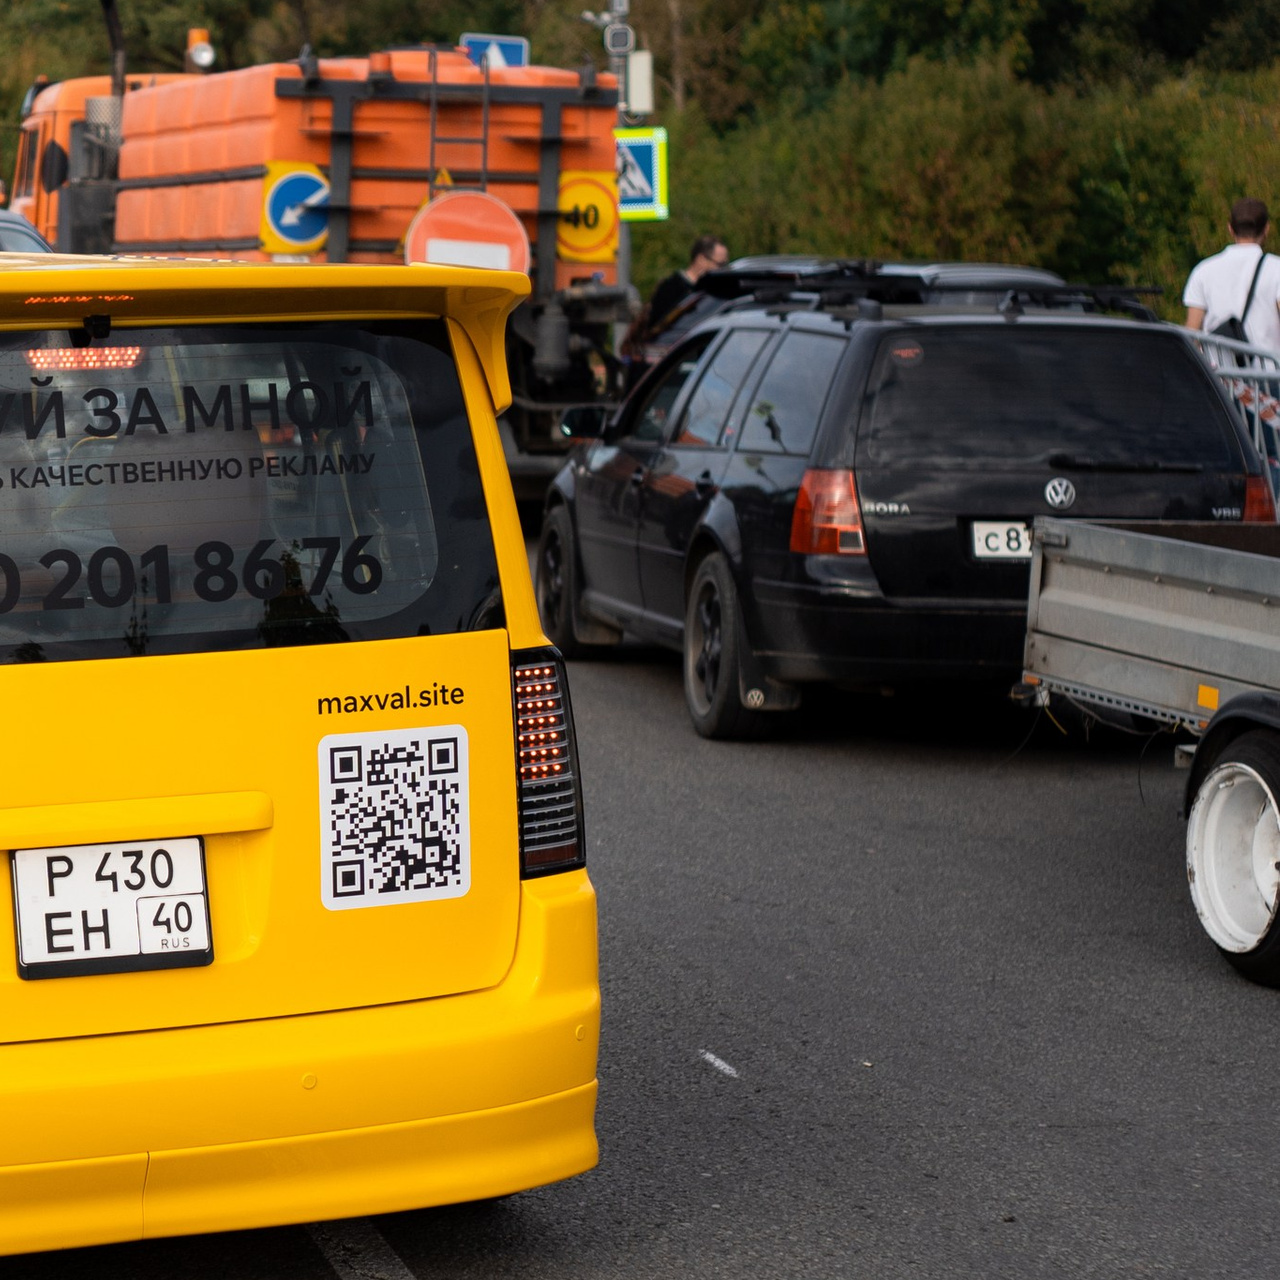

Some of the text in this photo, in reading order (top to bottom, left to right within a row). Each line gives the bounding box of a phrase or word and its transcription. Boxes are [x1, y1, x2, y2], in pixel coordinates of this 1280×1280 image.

[82, 386, 169, 438] ЗА
[183, 365, 375, 433] МНОЙ
[10, 457, 243, 490] КАЧЕСТВЕННУЮ
[249, 452, 376, 479] РЕКЛАМУ
[984, 527, 1032, 552] С8
[38, 544, 172, 611] 201
[192, 538, 286, 603] 86
[301, 534, 384, 596] 76
[317, 682, 465, 715] maxval.site
[95, 848, 174, 893] 430
[44, 901, 193, 954] ЕН 40
[160, 936, 191, 950] RUS
